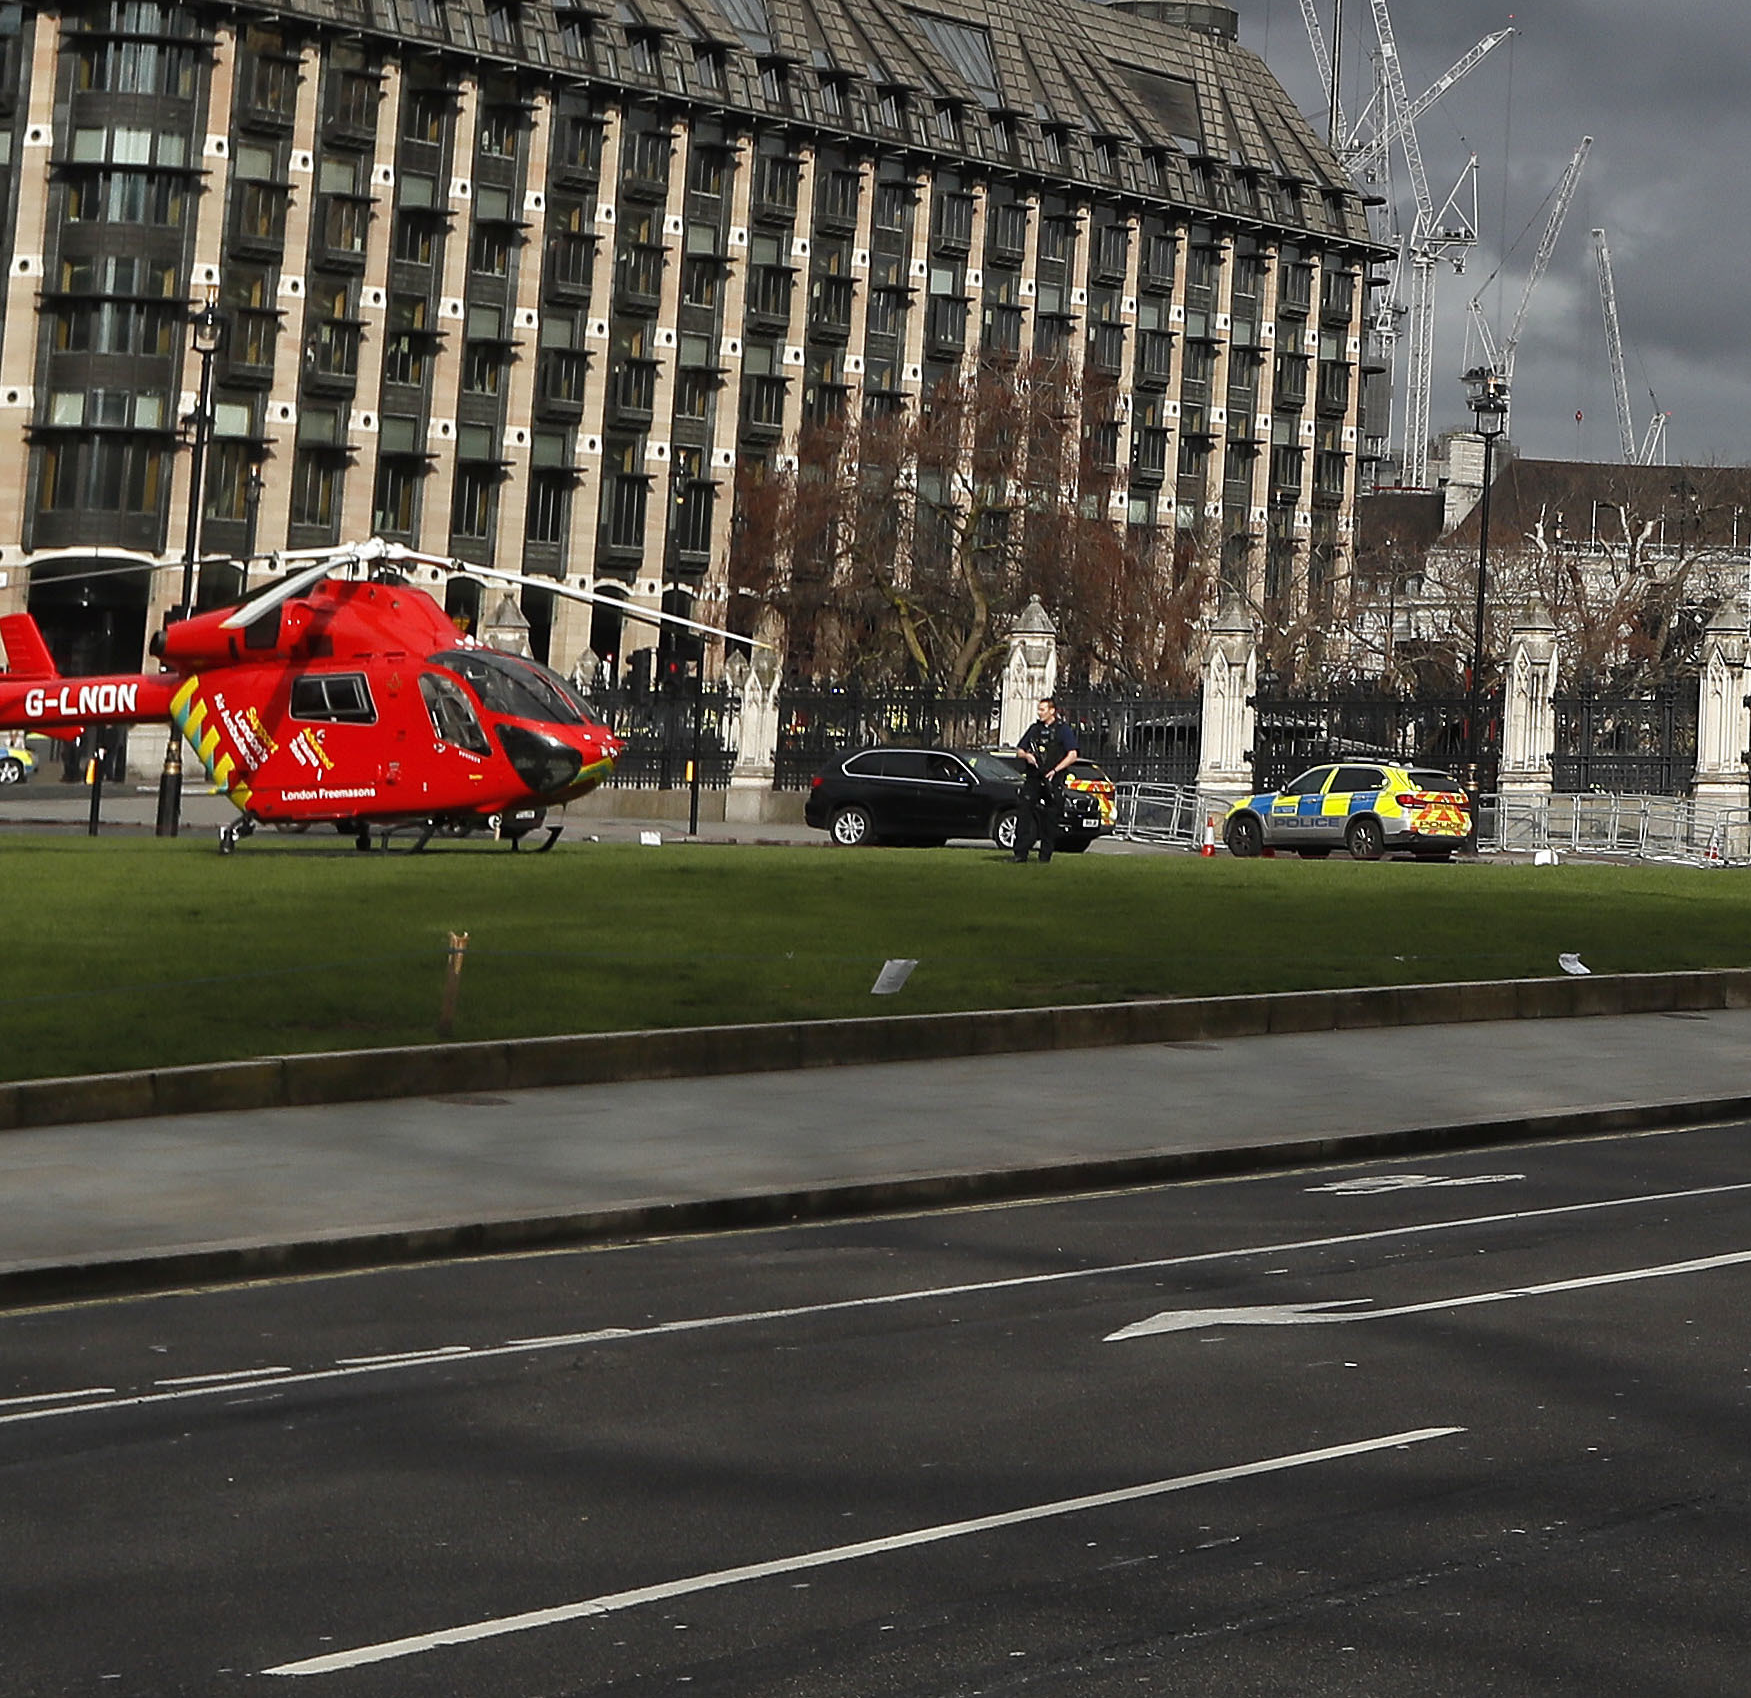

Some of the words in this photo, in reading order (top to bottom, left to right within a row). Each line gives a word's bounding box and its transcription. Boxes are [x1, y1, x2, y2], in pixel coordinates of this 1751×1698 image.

[214, 692, 225, 710] Air
[221, 709, 258, 771] Ambulance
[234, 710, 268, 763] London's
[246, 706, 279, 754] Support
[281, 789, 318, 801] London
[319, 787, 376, 799] Freemasons
[1274, 817, 1340, 828] POLICE
[1420, 821, 1464, 830] POLICE
